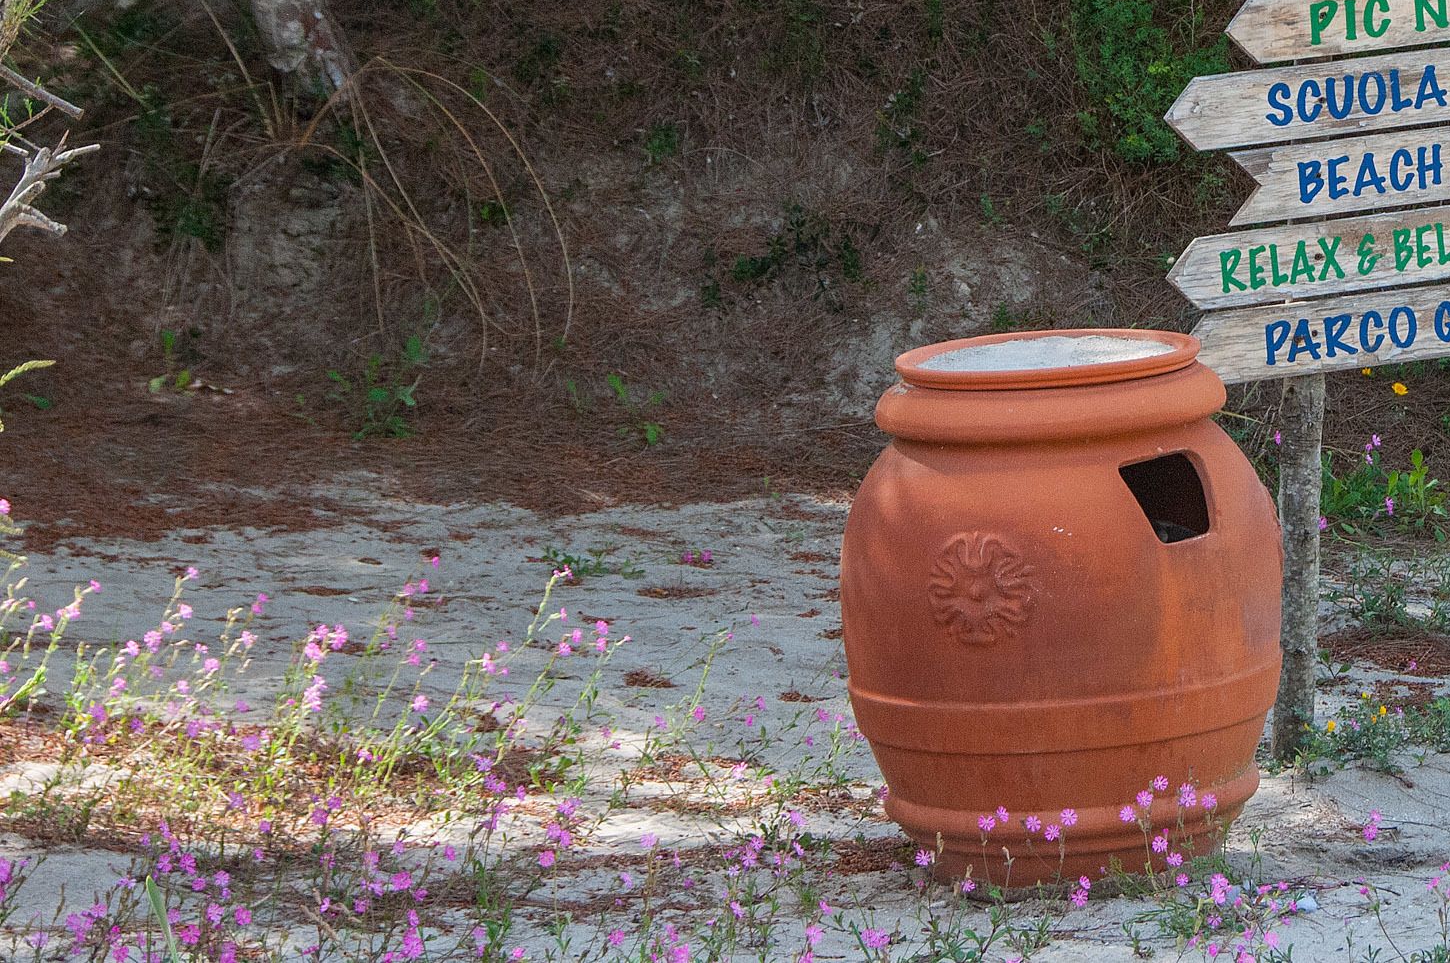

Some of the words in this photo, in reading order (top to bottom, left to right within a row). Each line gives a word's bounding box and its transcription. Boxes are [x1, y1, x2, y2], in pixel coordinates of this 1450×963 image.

[1266, 64, 1447, 126] SCUOLA
[1297, 144, 1444, 204] BEACH
[1219, 236, 1346, 294] RELAX
[1357, 234, 1384, 275] &
[1264, 307, 1417, 365] PARCO
